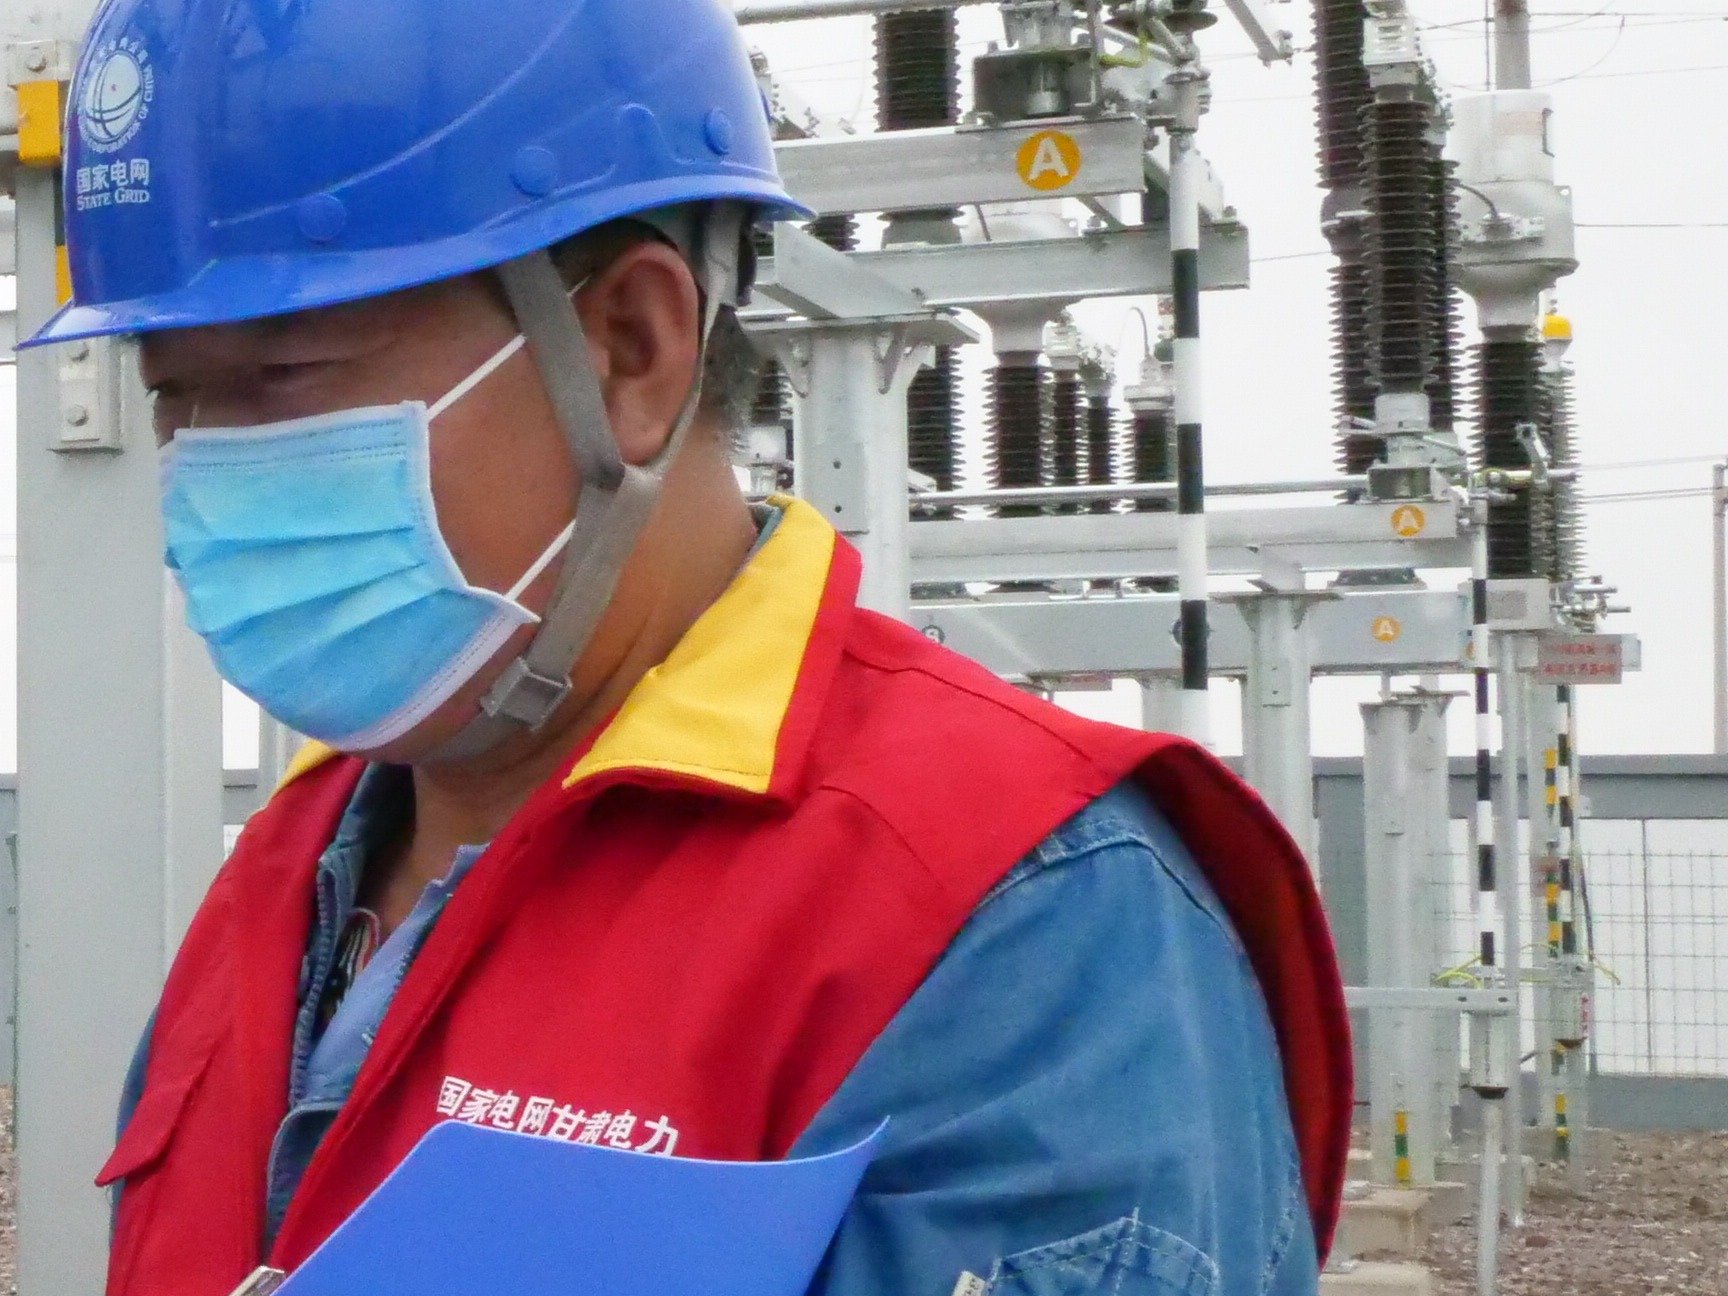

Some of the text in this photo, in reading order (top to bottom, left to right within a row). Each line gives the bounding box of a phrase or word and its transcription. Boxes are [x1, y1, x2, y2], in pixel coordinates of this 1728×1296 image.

[76, 158, 150, 195] 国家电网
[1028, 137, 1070, 181] A
[114, 186, 150, 205] GRID
[436, 1076, 679, 1157] 国家电网甘肃电力
